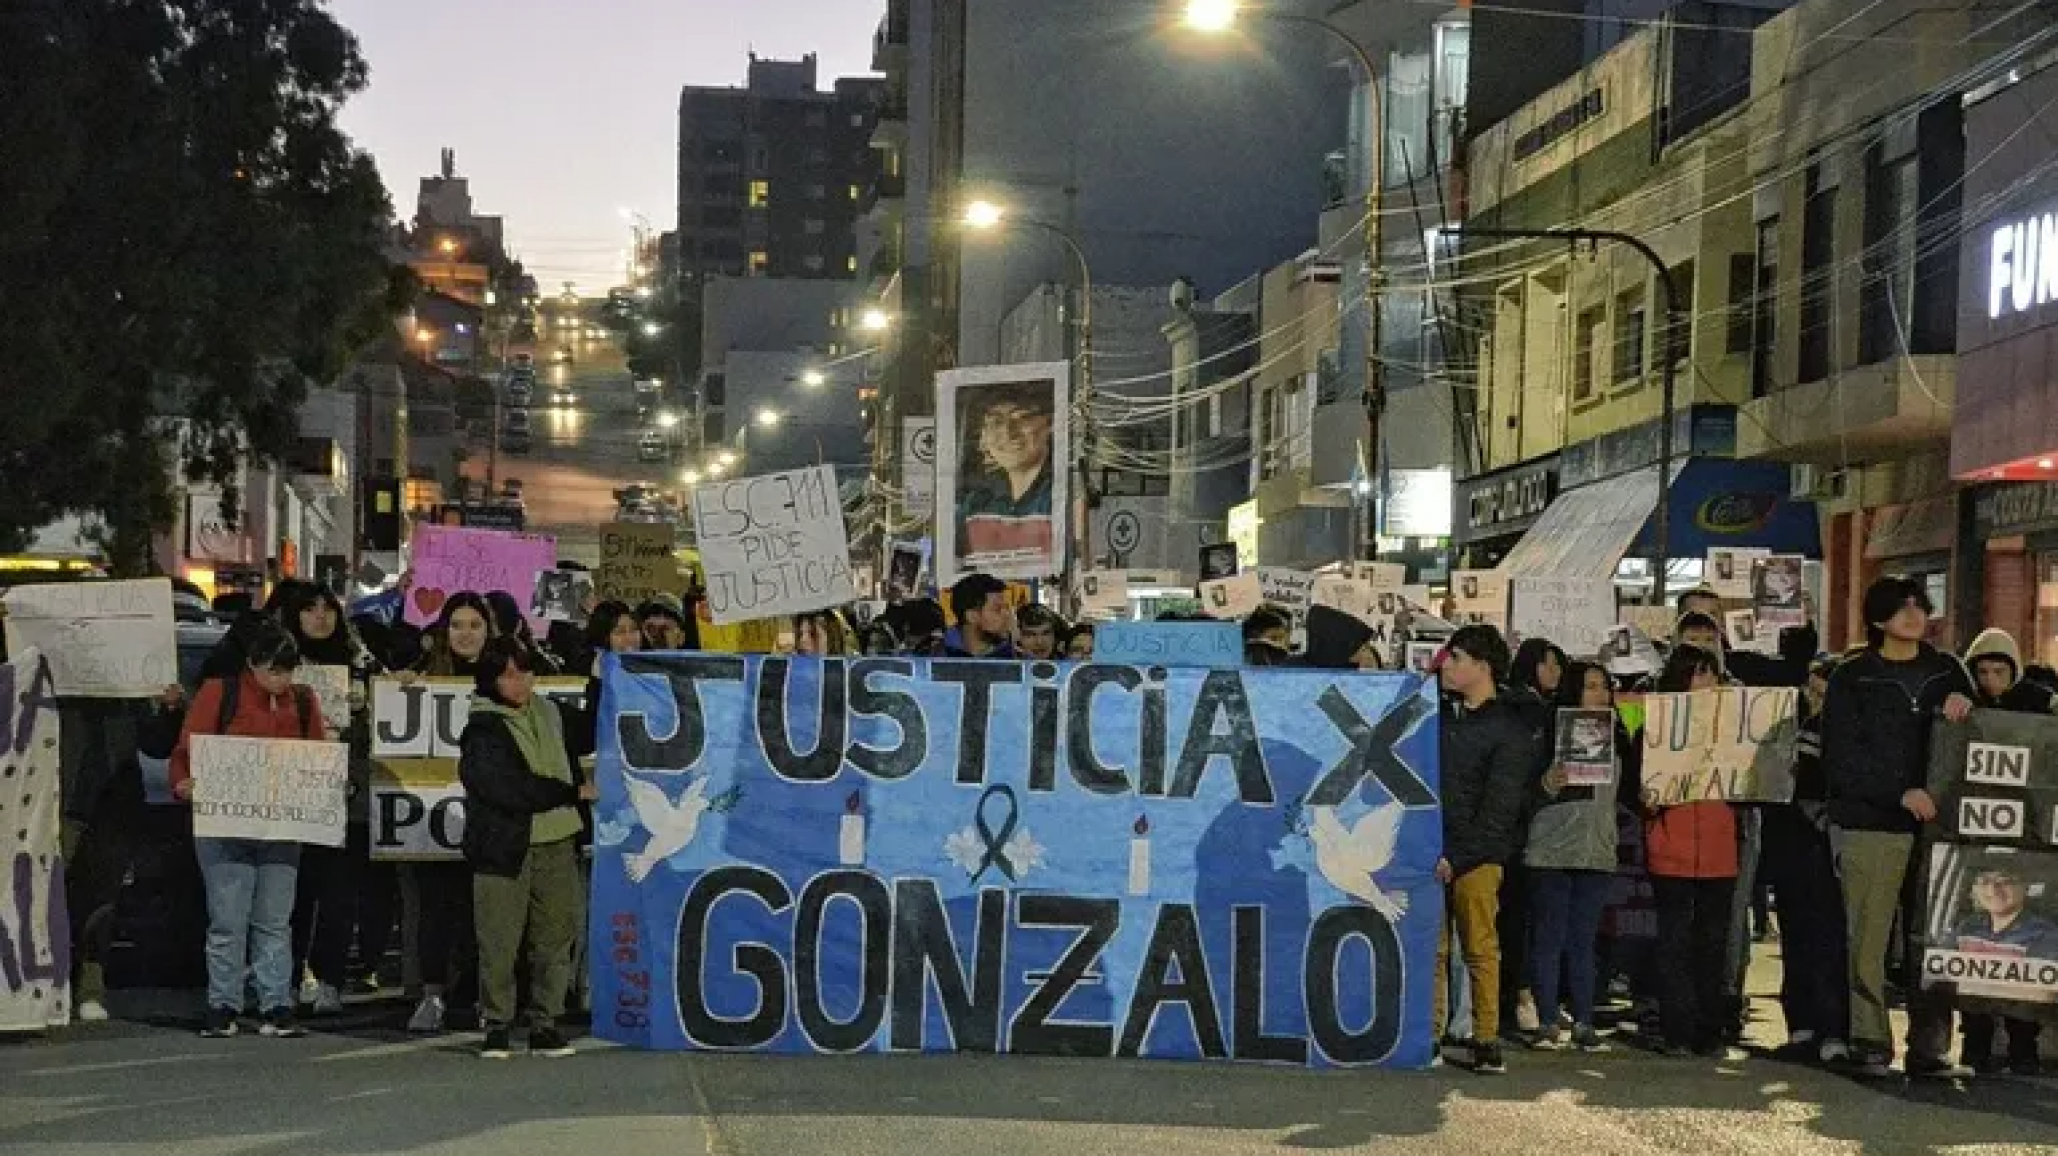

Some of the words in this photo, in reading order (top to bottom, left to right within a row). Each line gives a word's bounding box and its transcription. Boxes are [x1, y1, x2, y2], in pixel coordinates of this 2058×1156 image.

[739, 531, 804, 563] PIDE
[1305, 683, 1439, 810] X
[1970, 748, 2024, 779] SIN
[1963, 802, 2017, 831] NO
[674, 863, 1405, 1068] GONZALO
[1927, 955, 2058, 985] GONZALO
